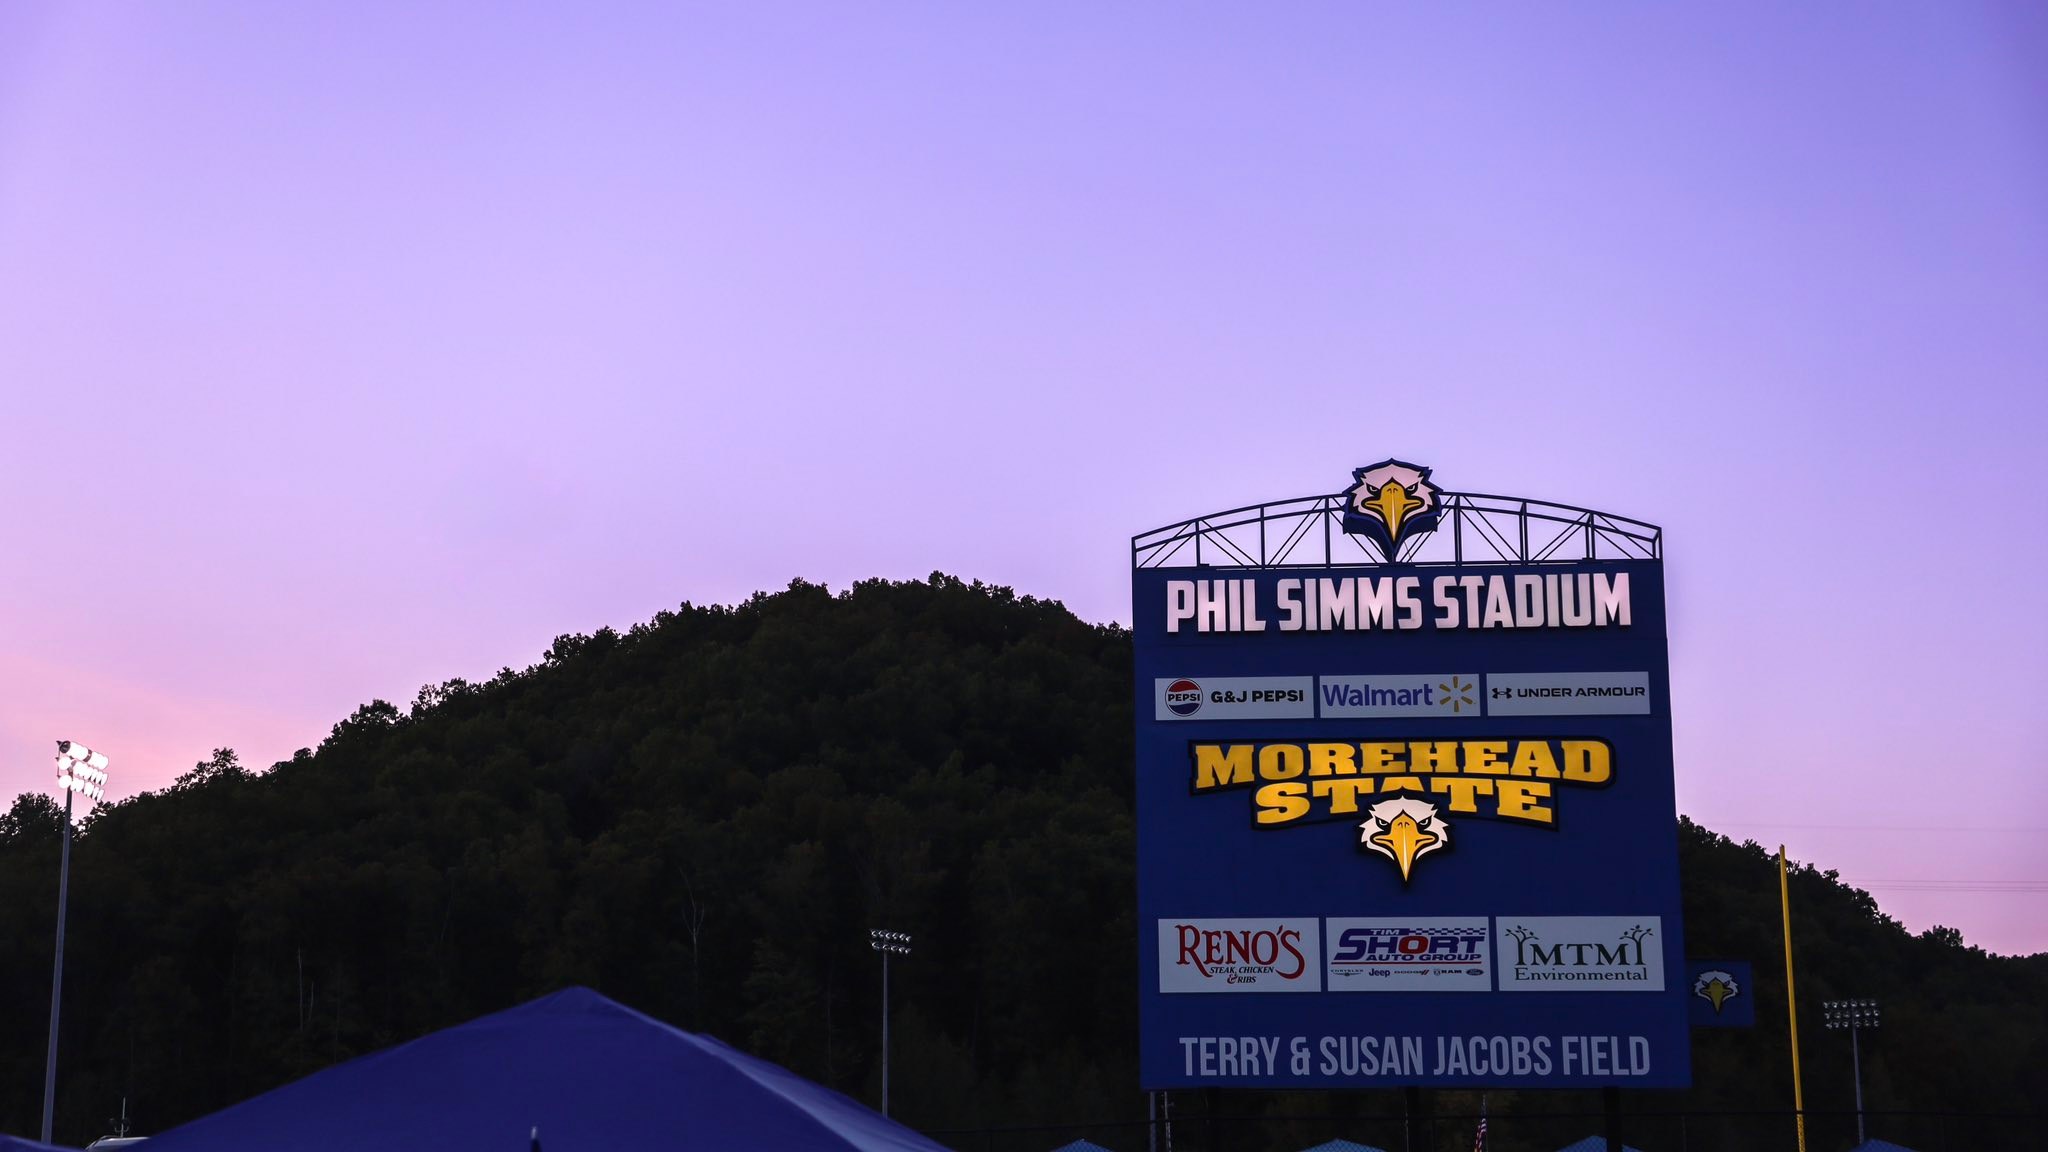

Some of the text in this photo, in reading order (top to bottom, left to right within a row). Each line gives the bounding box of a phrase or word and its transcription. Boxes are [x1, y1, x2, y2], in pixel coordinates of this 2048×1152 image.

[1167, 573, 1631, 632] PHIL SIMMS STADIUM
[1168, 693, 1200, 702] PEPSI
[1211, 690, 1303, 703] G&J PEPSI
[1322, 683, 1433, 707] Walmart
[1517, 687, 1645, 698] UNDER ARMOUR
[1195, 740, 1611, 789] MOREHEAD
[1333, 928, 1485, 961] SHORT
[1175, 924, 1305, 979] RENO'S
[1419, 953, 1482, 961] GROUP
[1238, 965, 1275, 974] CHICKEN
[1369, 968, 1390, 978] Jeep
[1514, 967, 1648, 981] Environmental
[1237, 976, 1257, 984] RIBS
[1179, 1036, 1651, 1076] TERRY & SUSAN JACOBS FIELD
